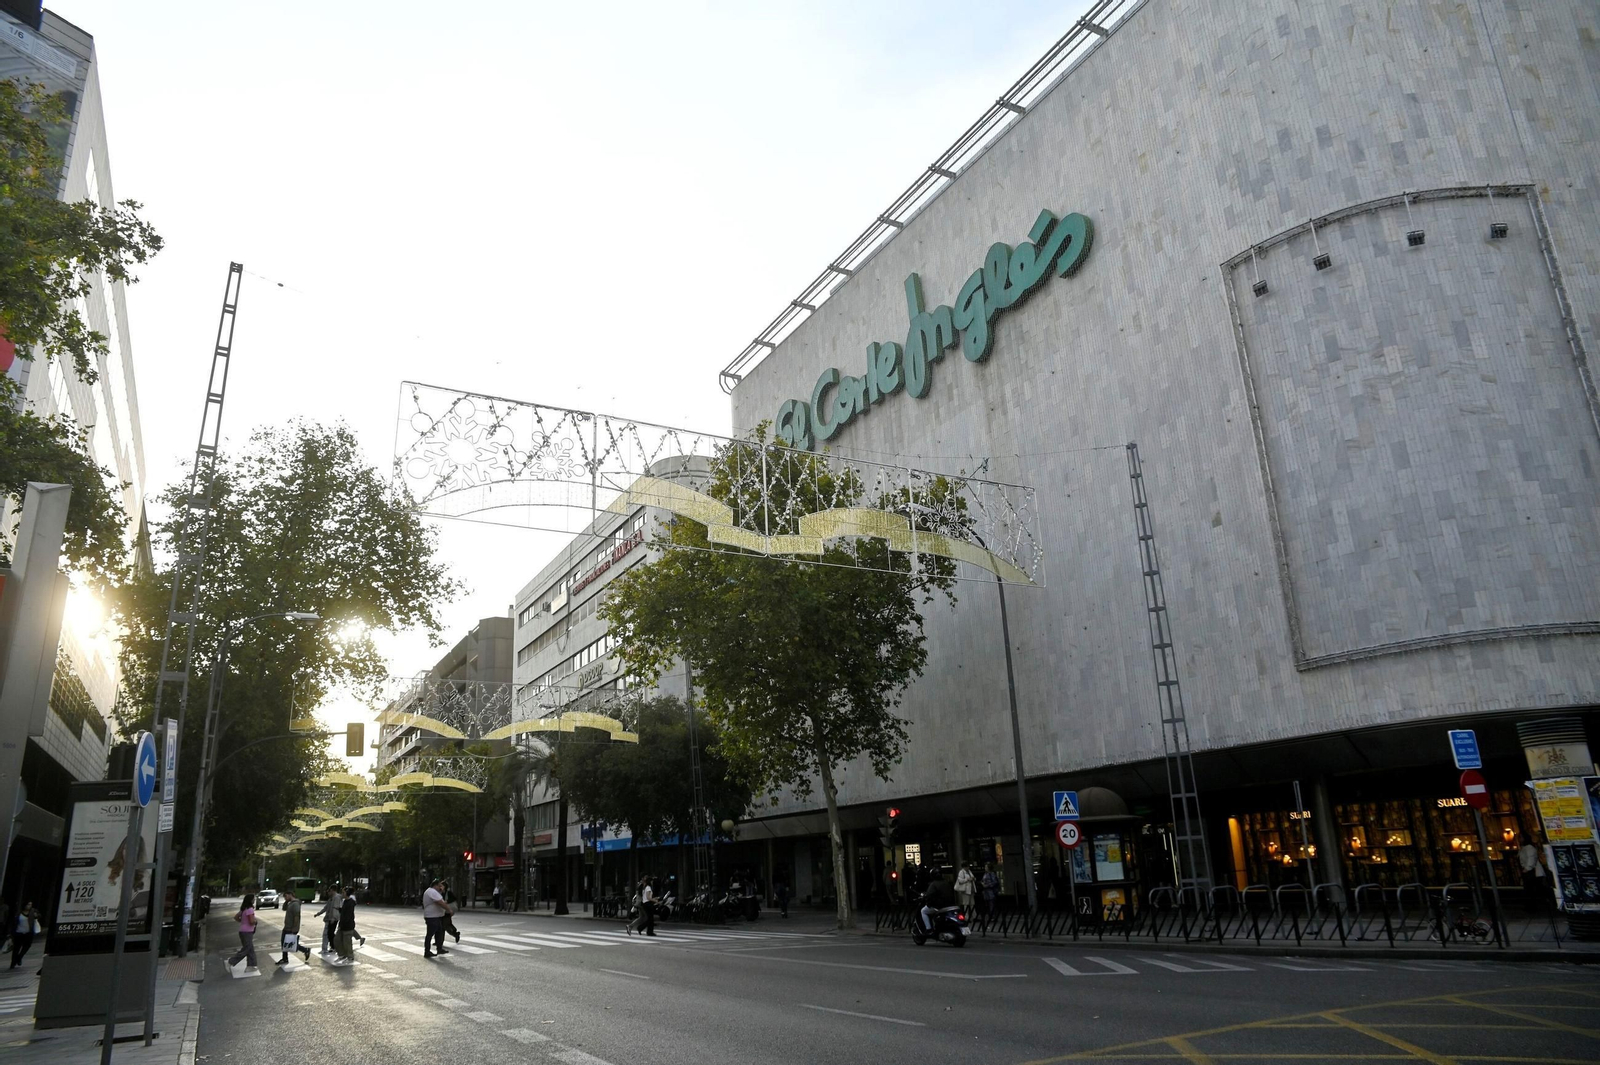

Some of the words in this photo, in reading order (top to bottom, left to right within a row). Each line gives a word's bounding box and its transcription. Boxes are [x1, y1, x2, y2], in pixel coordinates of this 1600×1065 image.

[776, 399, 811, 450] El
[810, 341, 903, 441] Corte
[904, 208, 1094, 399] Inglés
[1062, 829, 1076, 838] 20
[75, 886, 95, 898] 120
